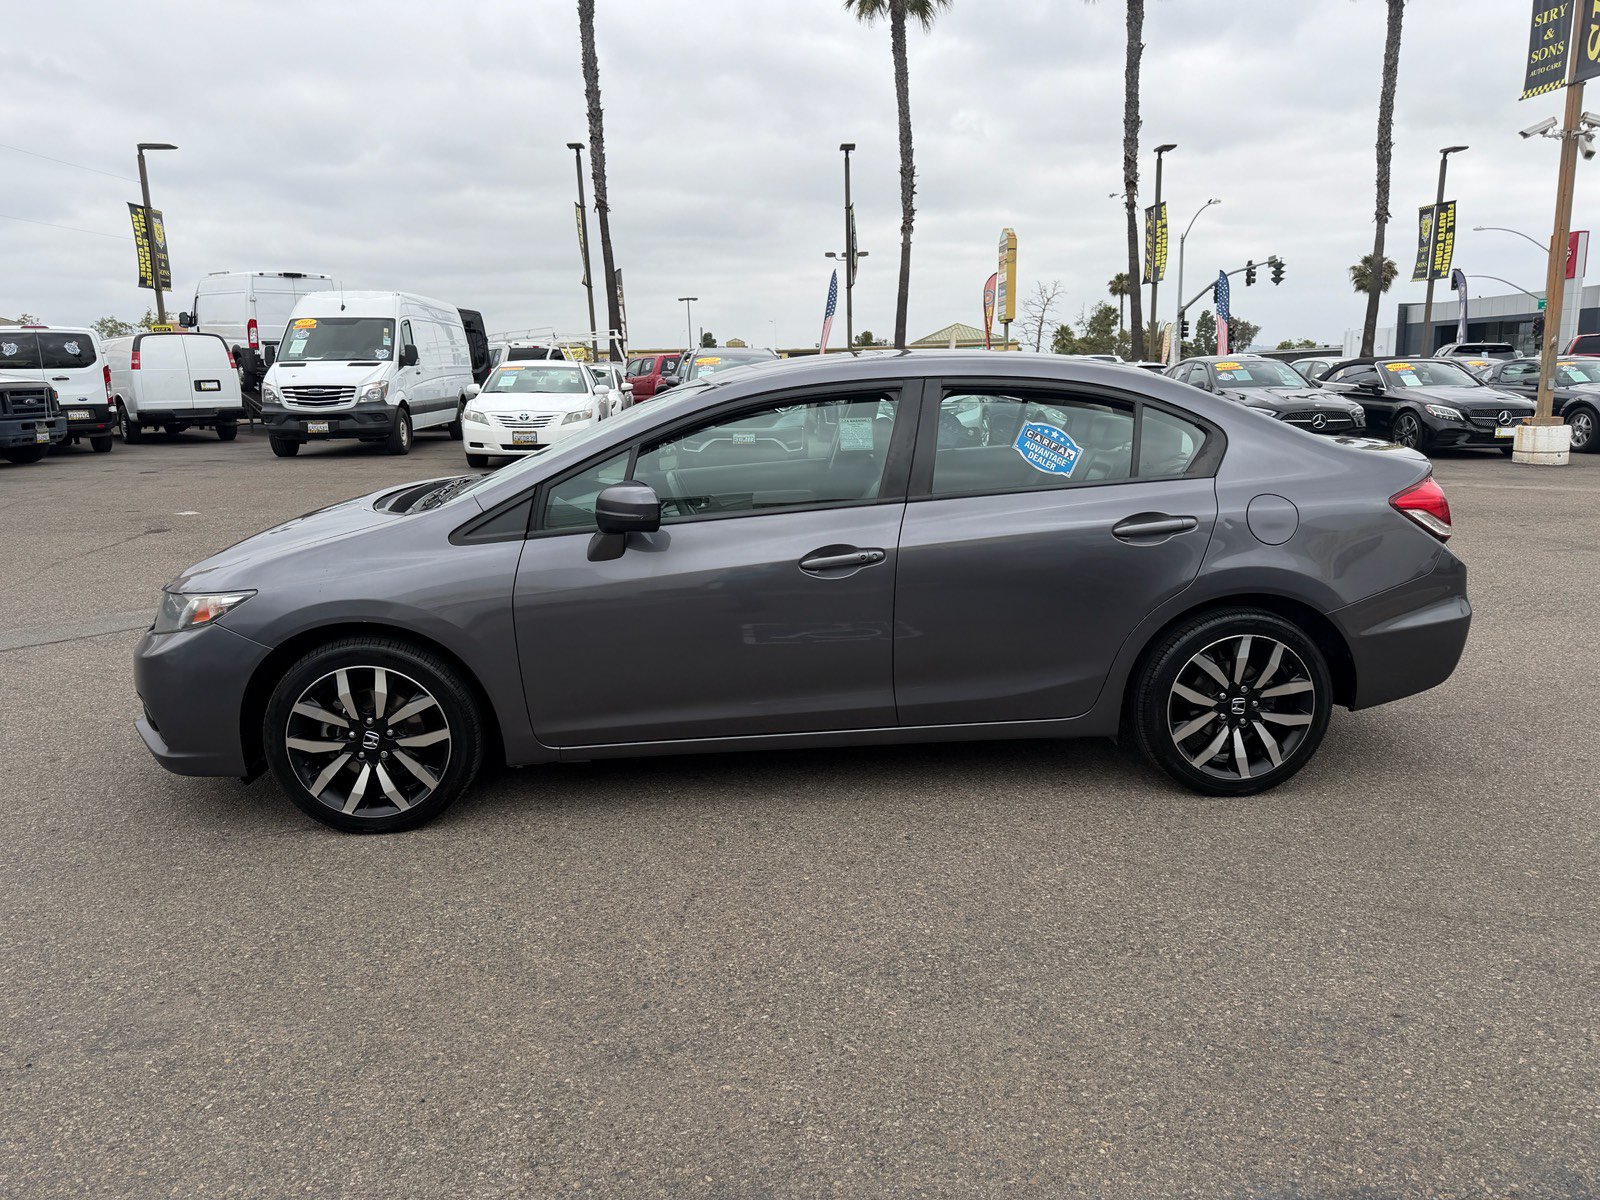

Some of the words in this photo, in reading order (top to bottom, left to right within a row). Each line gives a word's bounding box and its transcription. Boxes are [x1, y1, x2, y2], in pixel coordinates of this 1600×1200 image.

[1534, 2, 1568, 27] SIRY
[1543, 28, 1555, 41] &
[1530, 40, 1565, 64] SONS
[1529, 66, 1546, 77] AUTO
[1546, 60, 1562, 72] CARE
[1437, 212, 1447, 241] AUTO
[1446, 203, 1455, 228] FULL
[131, 213, 143, 246] AUTO
[138, 247, 147, 277] CARE
[136, 207, 147, 234] FULL
[142, 238, 153, 287] SERVICE
[1158, 227, 1168, 279] FINANCE
[1434, 242, 1445, 271] CARE
[1441, 231, 1454, 277] SERVICE
[1024, 440, 1068, 467] ADVANTAGE
[1026, 429, 1075, 460] CARFAX
[1027, 451, 1057, 471] DEALER
